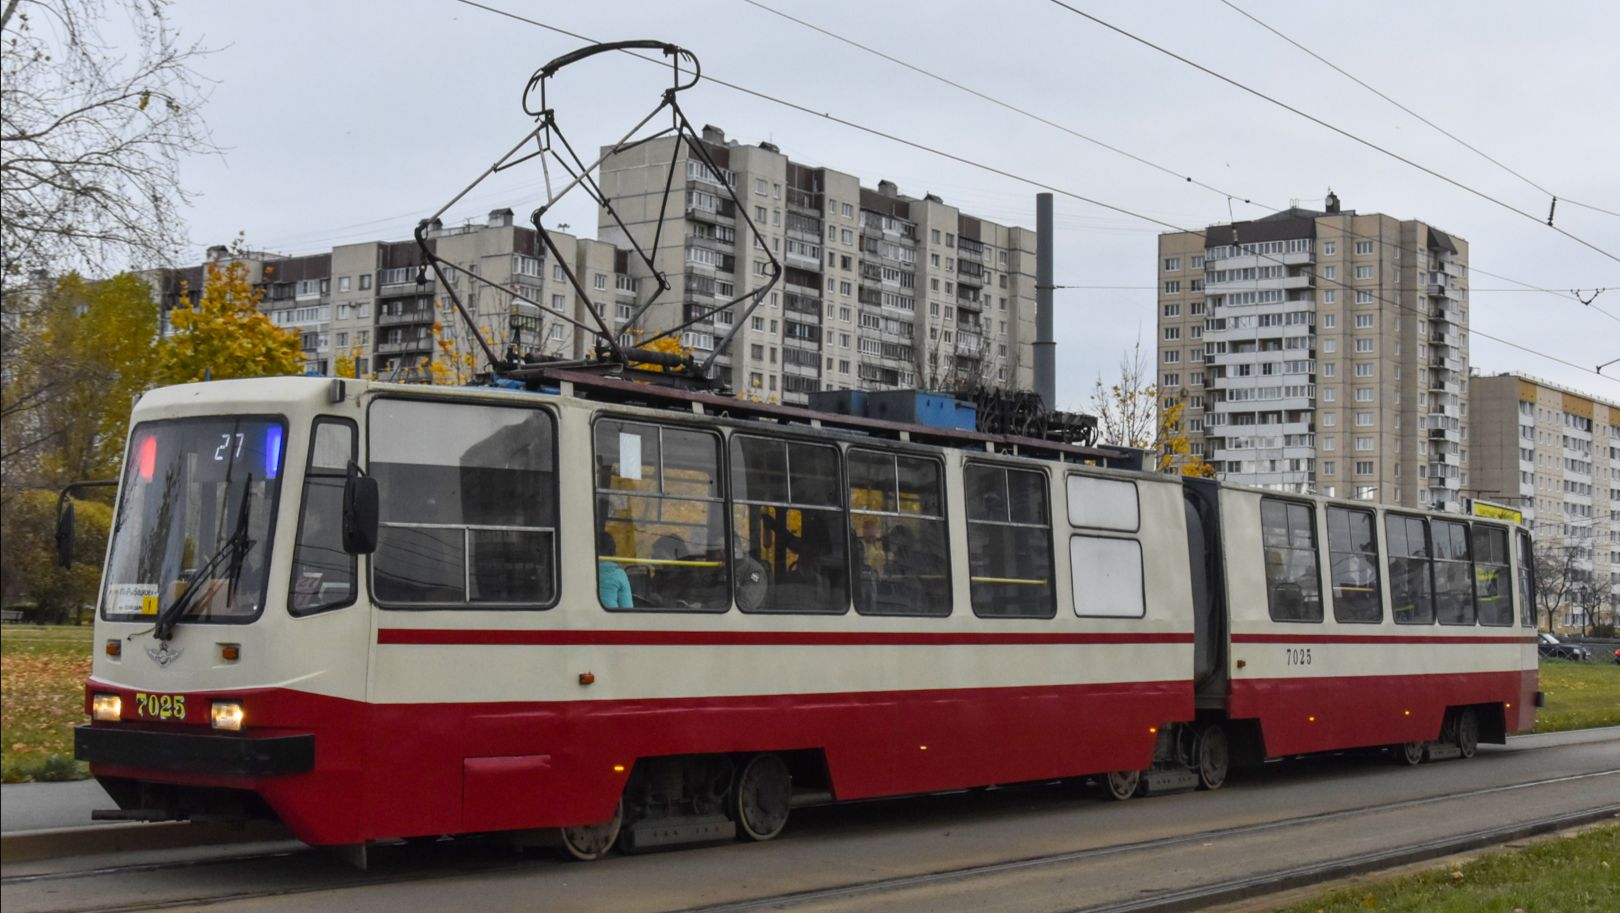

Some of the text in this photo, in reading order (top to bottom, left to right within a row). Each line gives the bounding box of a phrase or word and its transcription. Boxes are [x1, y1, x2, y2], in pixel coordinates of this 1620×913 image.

[214, 433, 244, 460] 27
[1286, 648, 1312, 666] 7025
[136, 692, 186, 720] 7025
